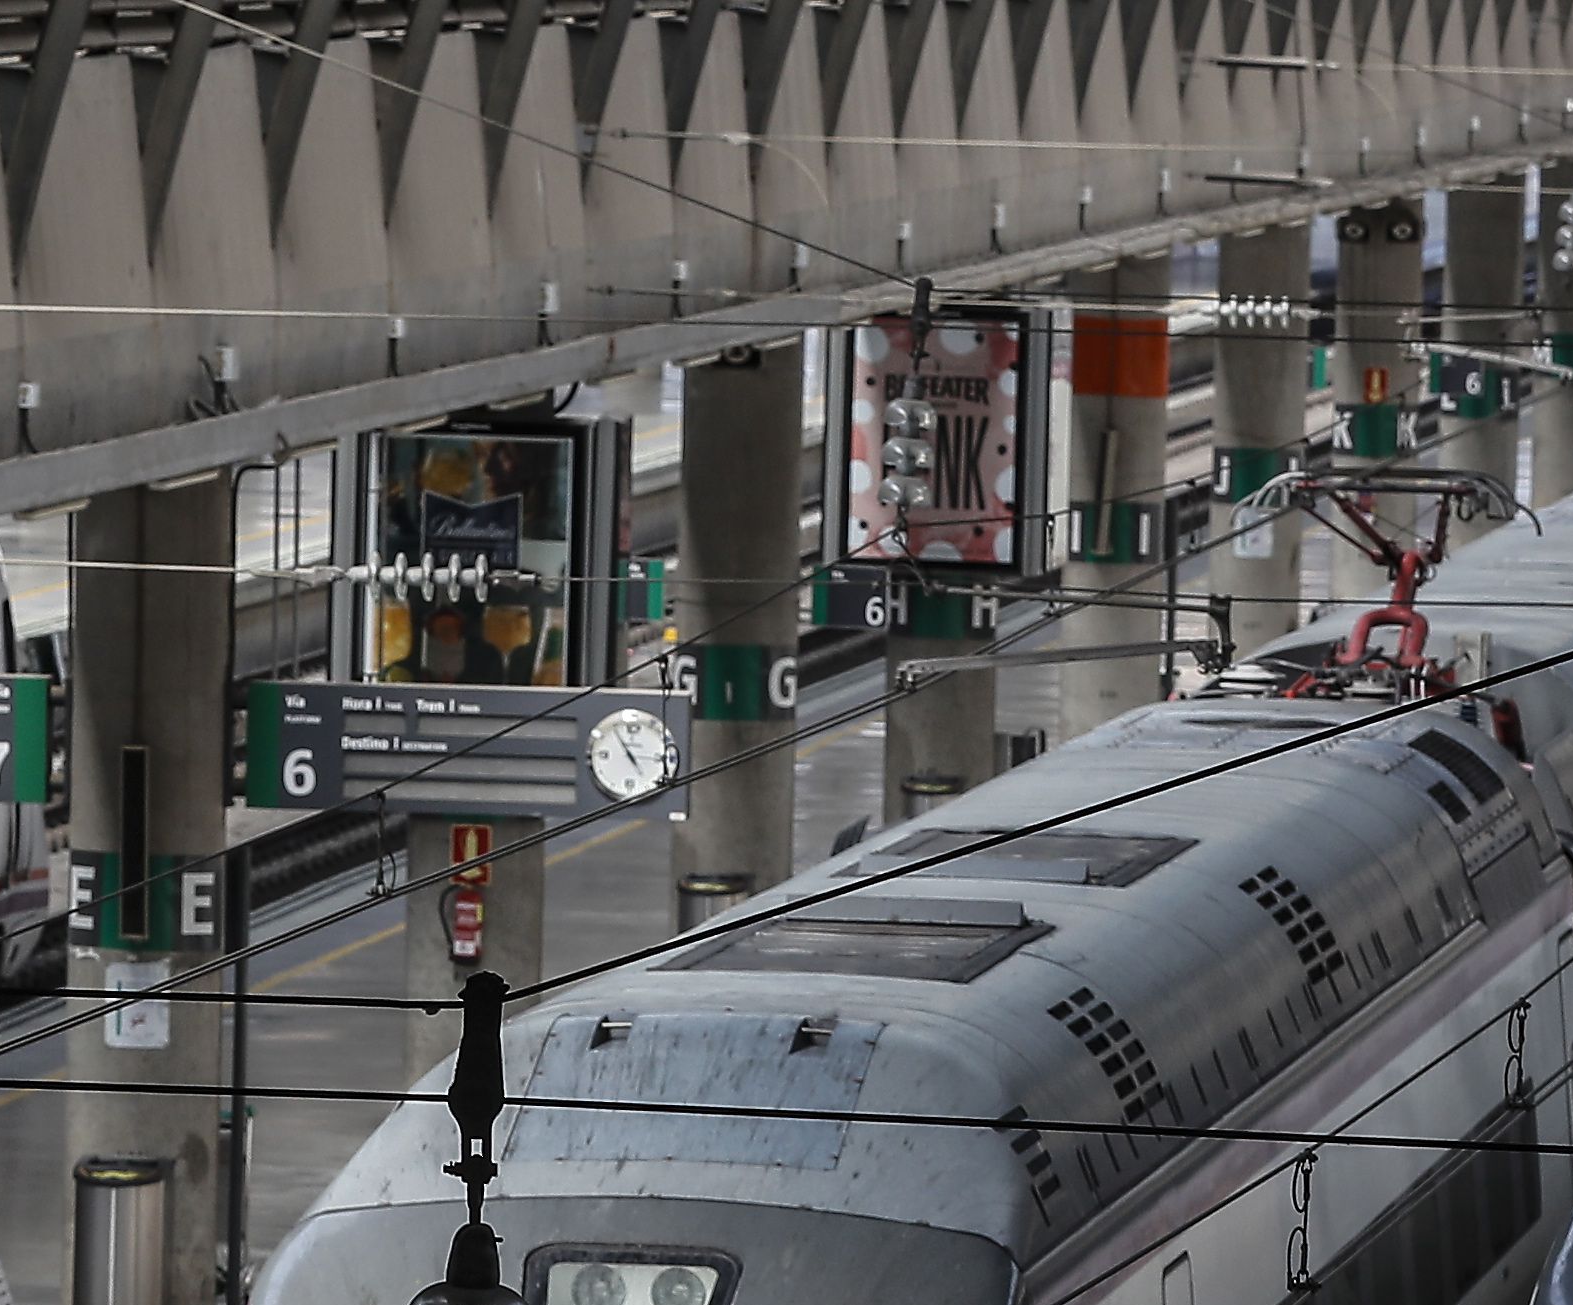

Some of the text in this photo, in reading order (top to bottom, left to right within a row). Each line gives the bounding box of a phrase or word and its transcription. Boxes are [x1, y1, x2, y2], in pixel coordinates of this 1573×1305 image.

[1465, 371, 1482, 396] 6
[1332, 412, 1354, 449] K
[1397, 411, 1418, 449] K
[864, 596, 884, 627] 6
[971, 584, 998, 629] H
[768, 656, 799, 708] G
[341, 735, 389, 750] Destino
[282, 748, 317, 797] 6
[69, 865, 96, 931] E
[181, 871, 216, 936] E
